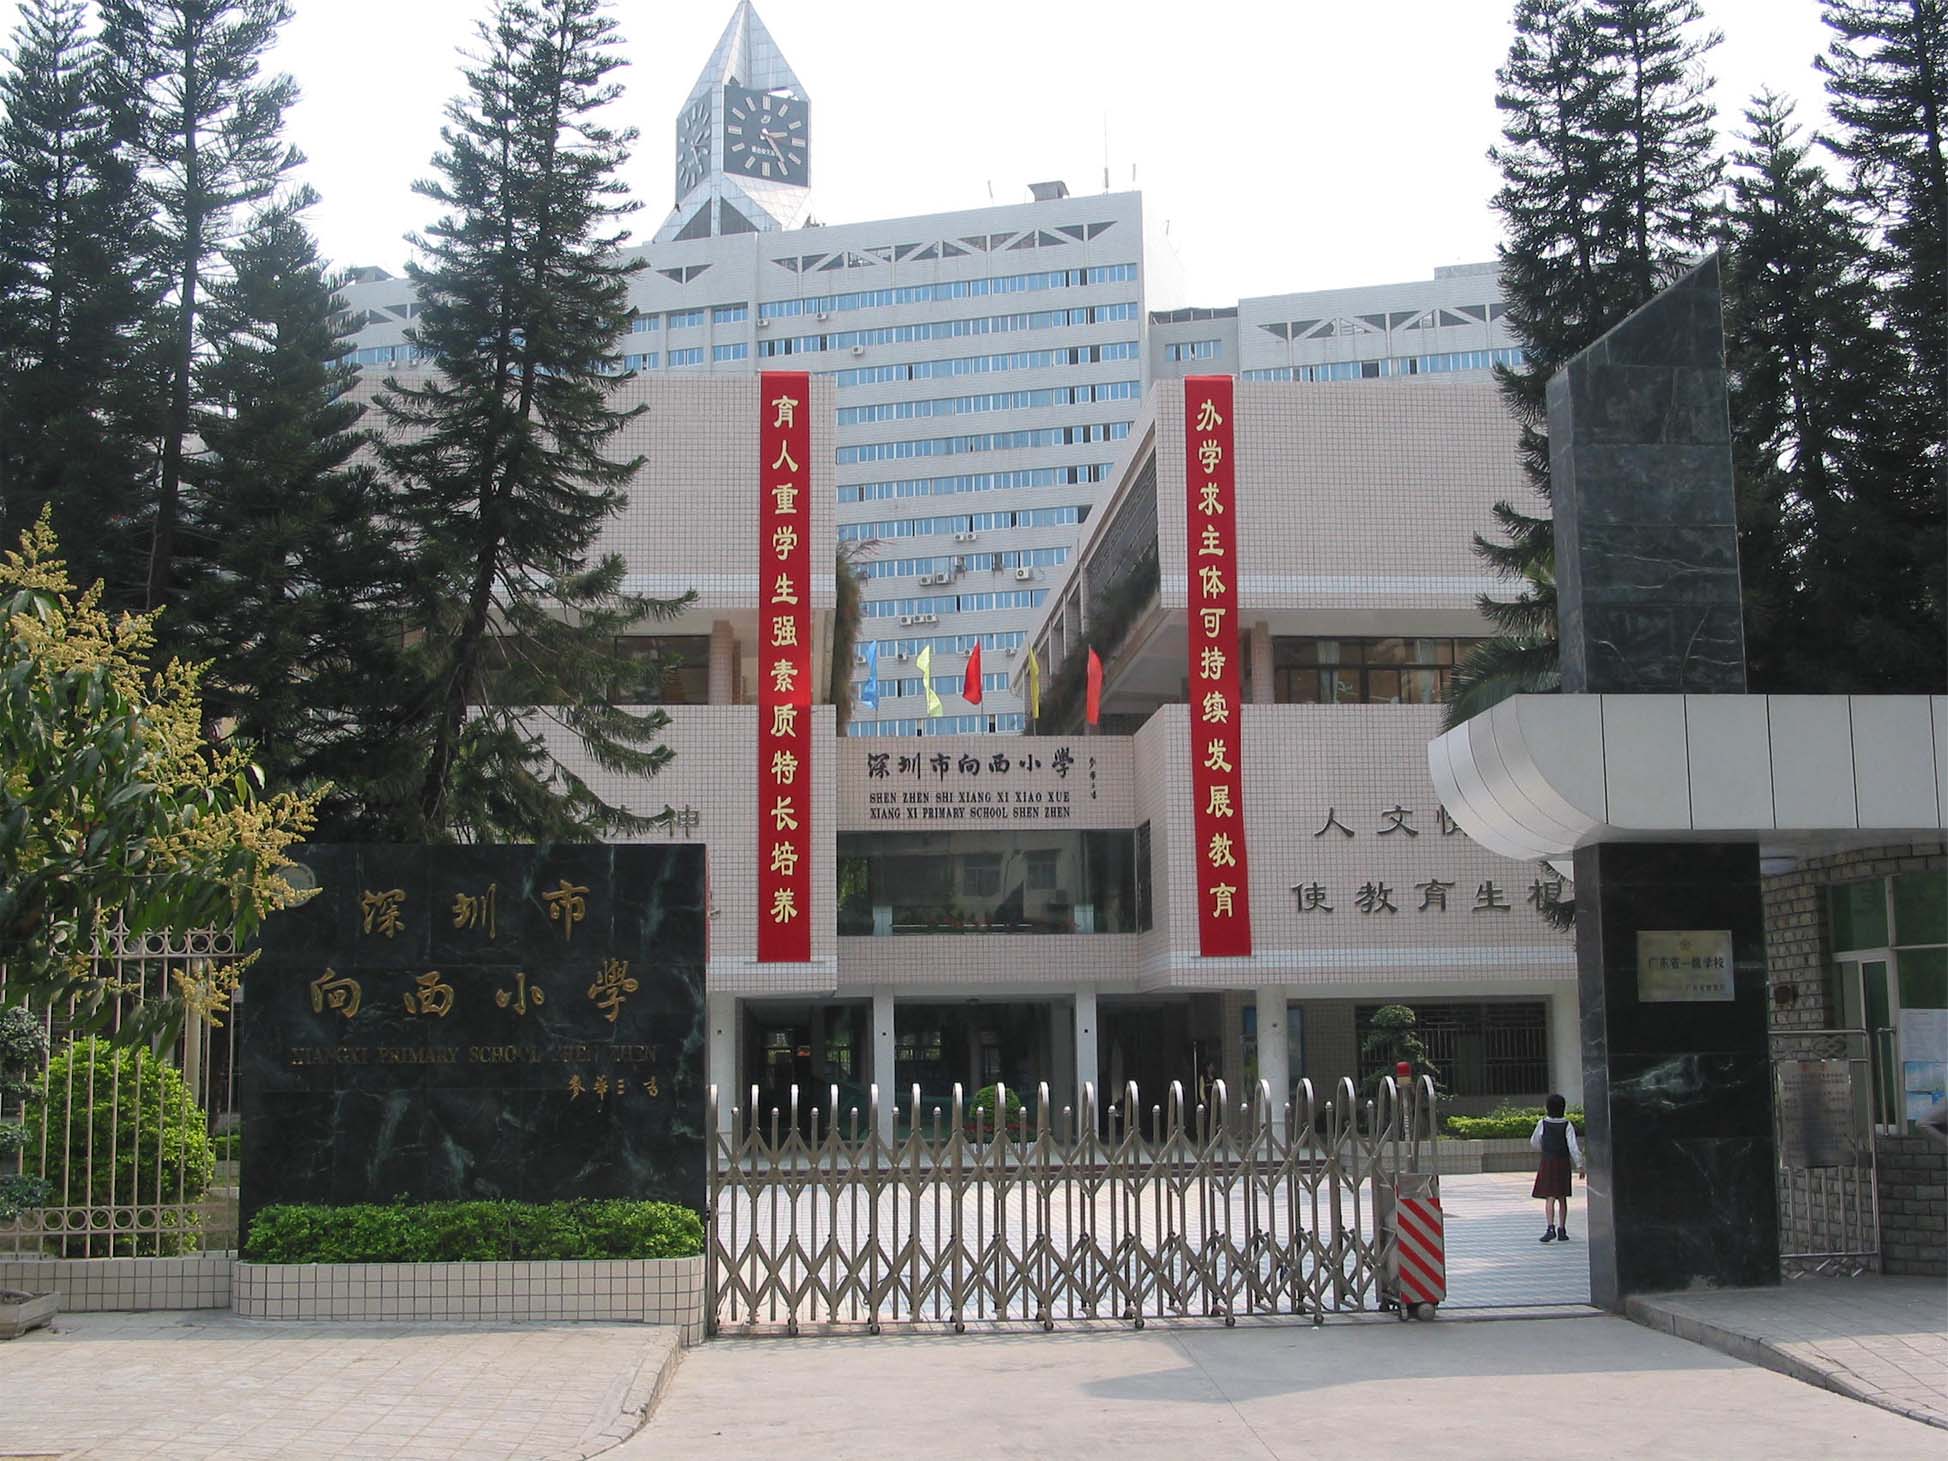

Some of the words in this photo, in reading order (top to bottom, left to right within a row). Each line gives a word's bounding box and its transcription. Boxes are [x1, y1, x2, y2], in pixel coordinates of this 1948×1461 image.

[770, 395, 799, 924] 育人重学生强素质特长培养
[1196, 399, 1237, 918] 办学求主体可持续发展教育
[869, 792, 897, 804] SHEN
[903, 792, 929, 804] ZHEN
[935, 792, 953, 804] SHI
[958, 791, 991, 804] XIANG
[997, 792, 1009, 804] XI
[1015, 792, 1042, 803] XIAO
[1048, 792, 1070, 803] XUE
[870, 807, 901, 819] XIANG
[907, 807, 918, 819] XI
[923, 807, 965, 819] PRIMARY
[970, 806, 1008, 818] SCHOOL
[1013, 807, 1039, 818] SHEN
[1044, 807, 1070, 818] ZHEN
[361, 880, 591, 942] 深圳市
[378, 1046, 459, 1065] PRIMARY
[469, 1045, 541, 1065] SCHOOL
